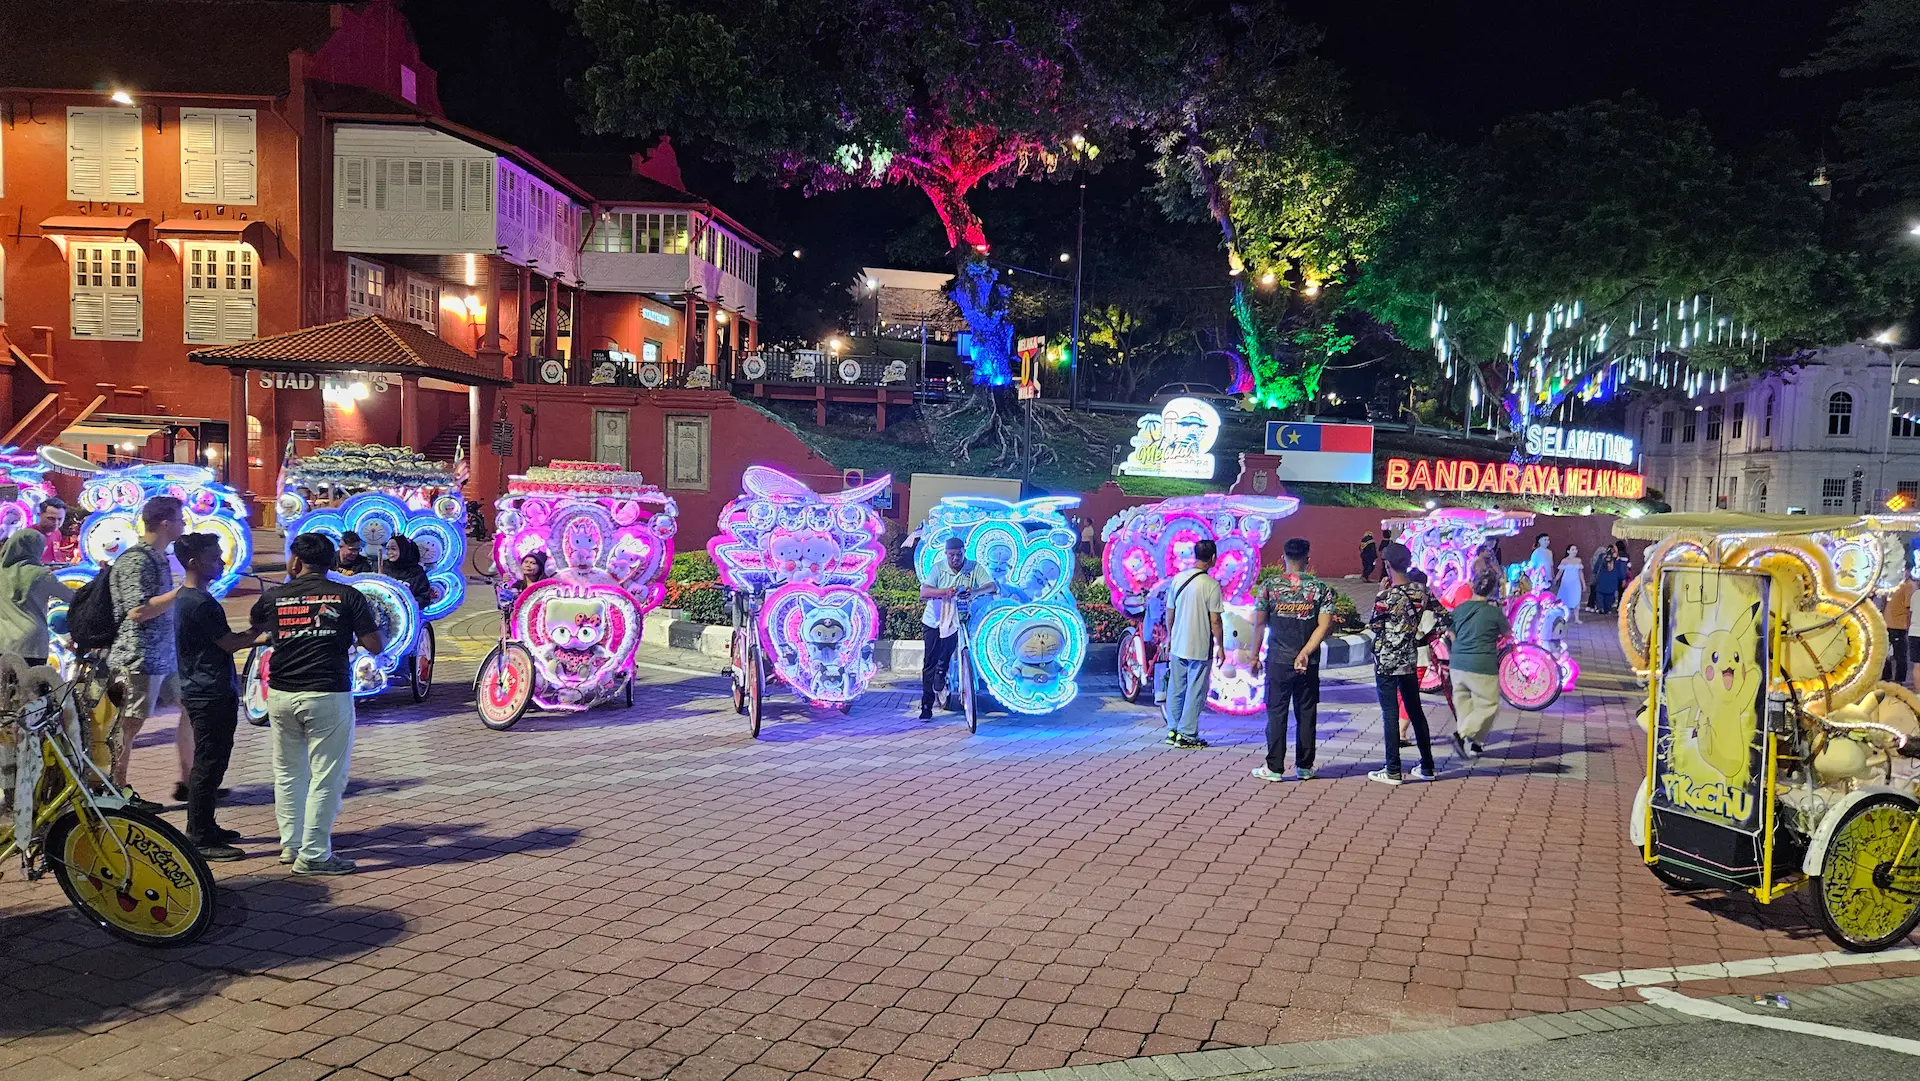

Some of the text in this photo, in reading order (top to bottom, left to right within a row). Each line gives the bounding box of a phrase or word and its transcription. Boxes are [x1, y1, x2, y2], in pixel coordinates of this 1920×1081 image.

[259, 372, 389, 393] STADTHYS
[1525, 424, 1605, 460] SELAMAT
[1386, 458, 1560, 496] BANDARAYA
[1564, 466, 1617, 497] MELAKA
